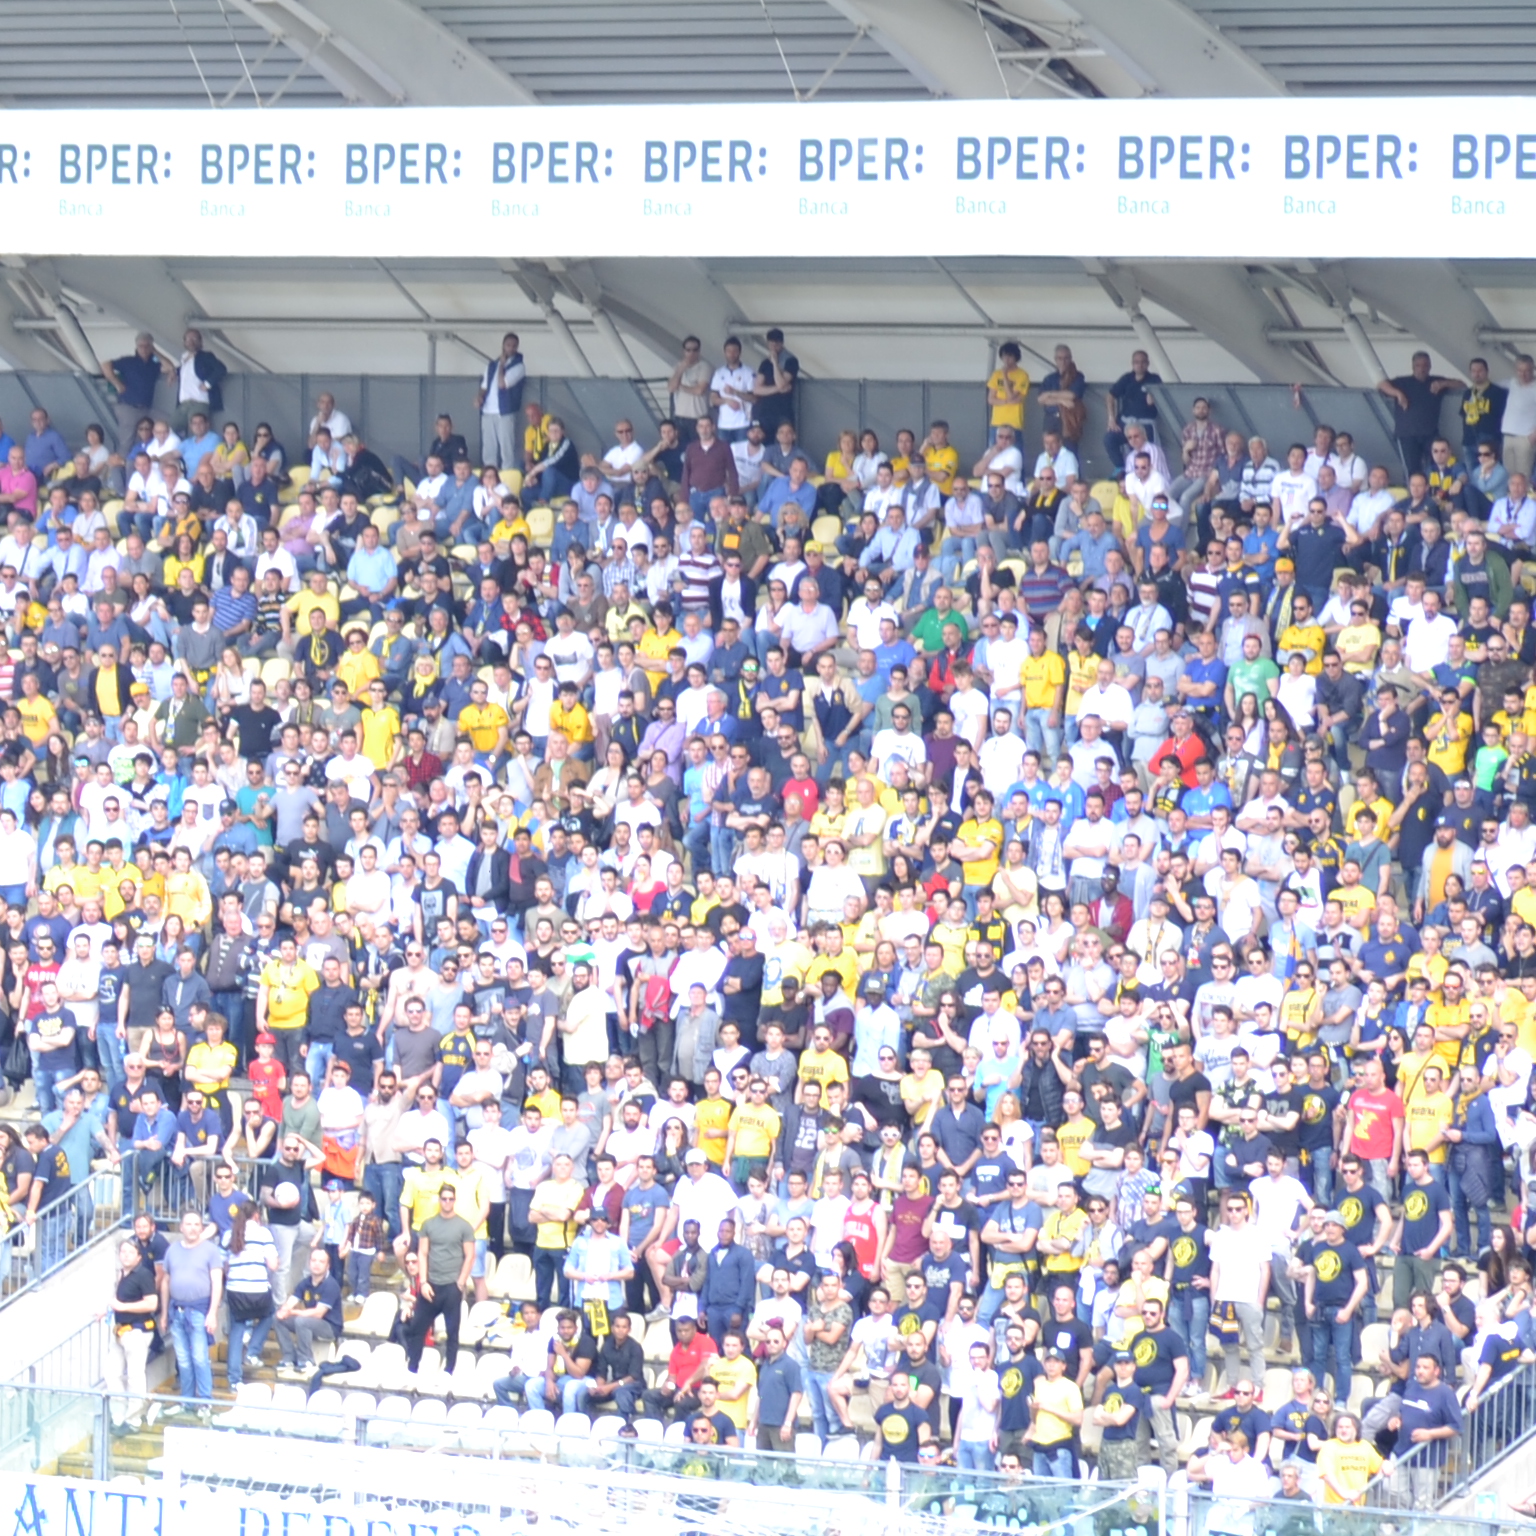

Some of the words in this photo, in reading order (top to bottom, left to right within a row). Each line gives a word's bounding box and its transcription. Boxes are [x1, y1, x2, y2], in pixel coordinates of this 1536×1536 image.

[60, 143, 171, 185] BPER:
[201, 143, 315, 185] BPER:
[346, 143, 461, 185] BPER:
[492, 141, 613, 184] BPER:
[644, 140, 767, 183] BPER:
[799, 137, 923, 182] BPER:
[956, 136, 1085, 181] BPER:
[1119, 135, 1250, 180] BPER:
[1284, 134, 1418, 179] BPER:
[59, 199, 103, 216] Banca
[200, 200, 245, 216] Banca
[345, 200, 390, 217] Banca
[492, 199, 539, 216] Banca
[644, 198, 692, 216] Banca
[799, 197, 848, 215] Banca
[956, 196, 1007, 214] Banca
[1118, 195, 1170, 214] Banca
[1284, 195, 1336, 214] Banca
[1452, 195, 1506, 215] Banca
